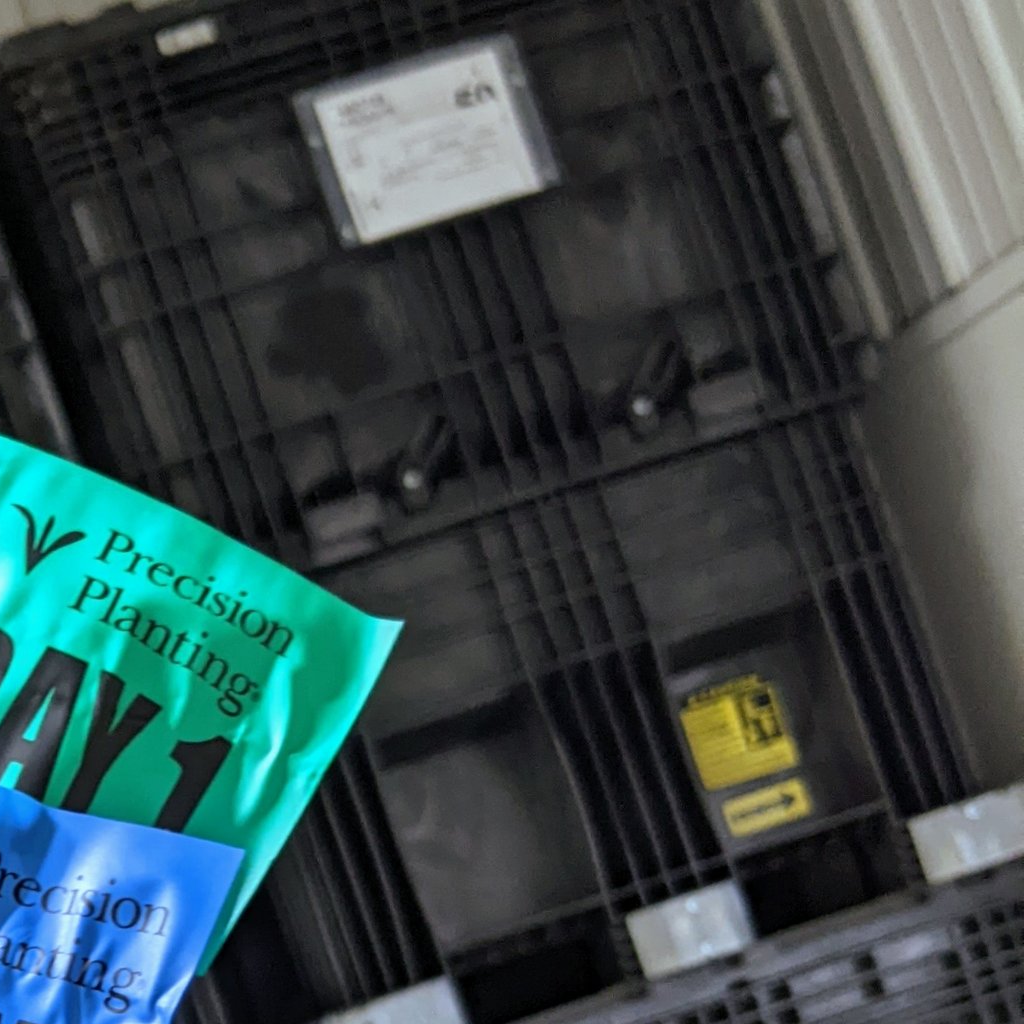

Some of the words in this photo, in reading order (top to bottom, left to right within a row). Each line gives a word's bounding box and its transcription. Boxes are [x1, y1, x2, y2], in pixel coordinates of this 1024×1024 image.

[68, 575, 259, 717] Planting
[94, 528, 294, 657] Precision
[156, 735, 237, 832] 1
